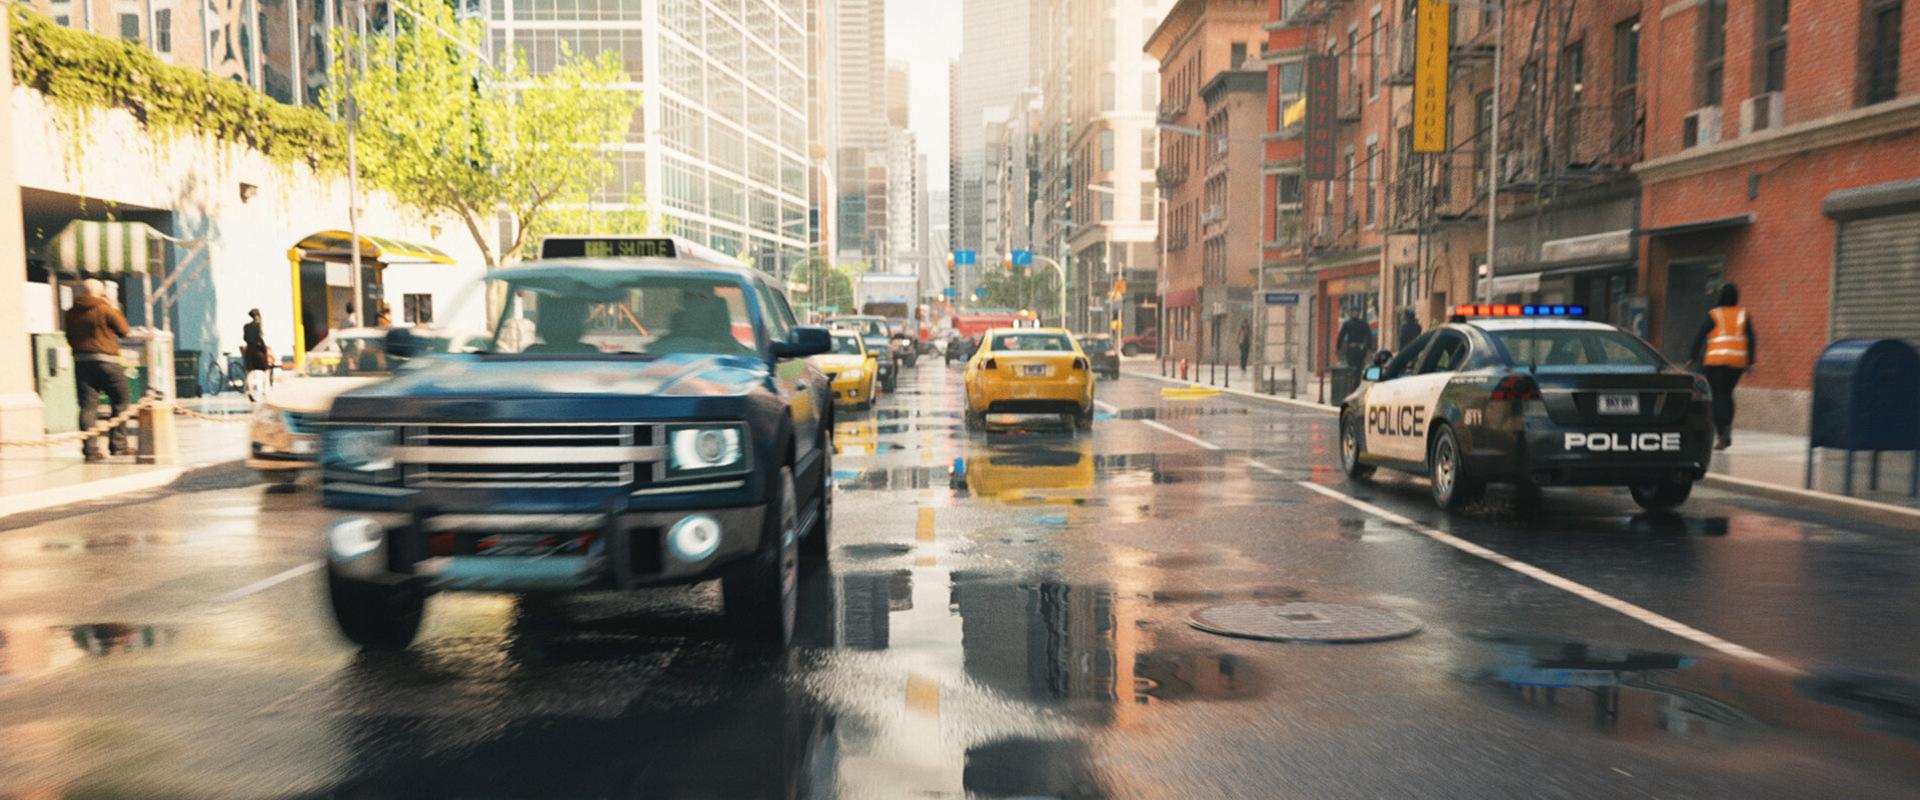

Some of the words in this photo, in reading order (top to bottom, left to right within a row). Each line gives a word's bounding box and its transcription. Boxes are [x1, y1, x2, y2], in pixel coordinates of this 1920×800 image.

[1314, 61, 1329, 174] TATTOOS
[1424, 86, 1436, 144] BOOK
[619, 240, 667, 257] SHUTTLE
[1368, 405, 1425, 437] POLICE
[1564, 432, 1681, 451] POLICE
